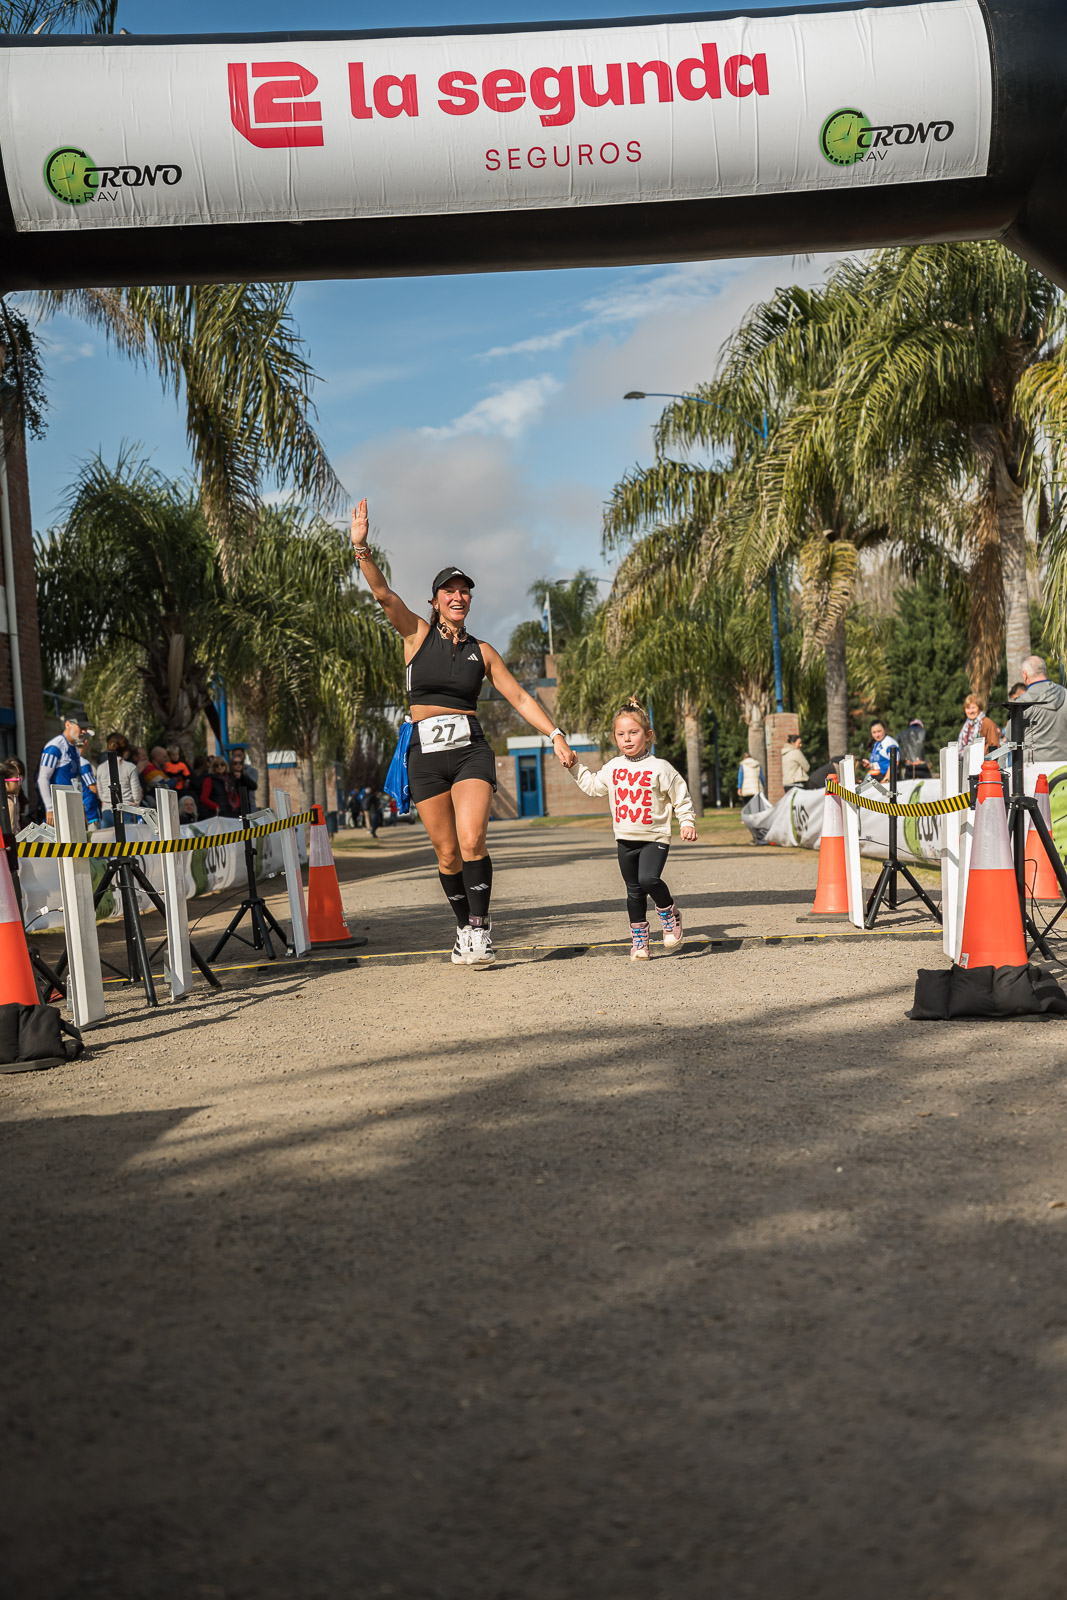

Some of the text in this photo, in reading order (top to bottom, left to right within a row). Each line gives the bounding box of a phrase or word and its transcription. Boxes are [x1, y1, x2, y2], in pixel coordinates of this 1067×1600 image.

[348, 43, 769, 127] la segunda
[857, 120, 954, 148] CRONO
[486, 141, 641, 171] SEGUROS
[854, 150, 888, 162] RAV
[83, 164, 182, 188] CRONO
[83, 191, 118, 202] RAV
[431, 723, 455, 743] 27
[612, 768, 653, 787] LOVE
[615, 804, 653, 825] LOVE
